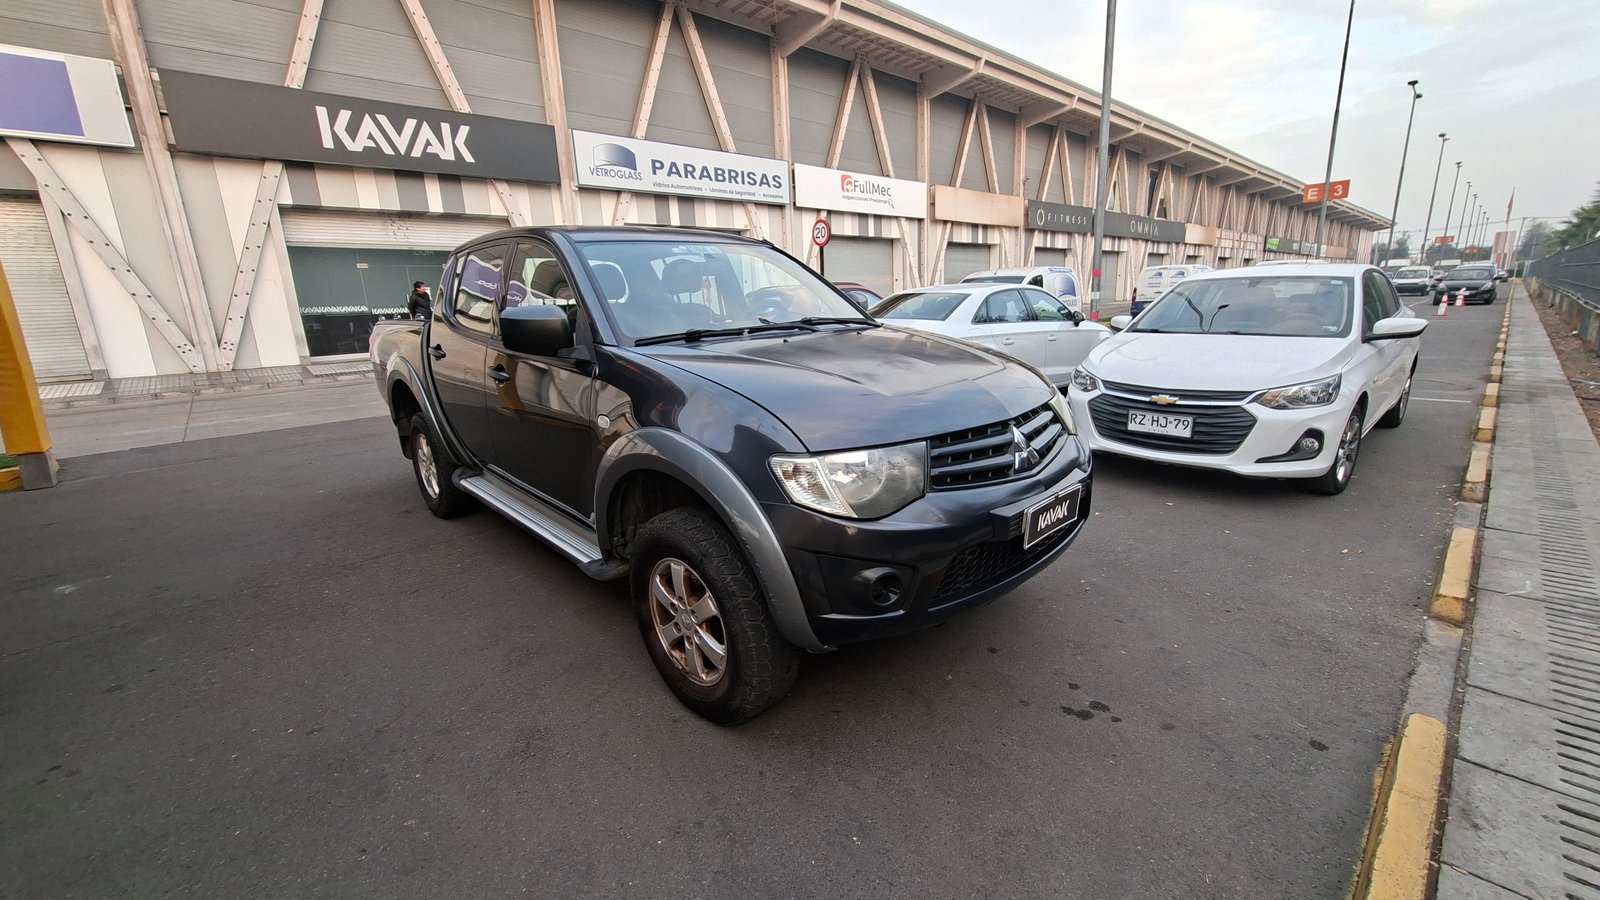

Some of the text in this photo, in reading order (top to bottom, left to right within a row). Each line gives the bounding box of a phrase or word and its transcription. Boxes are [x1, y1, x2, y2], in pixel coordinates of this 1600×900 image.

[315, 105, 476, 163] KAVAK
[588, 165, 643, 181] VETROGLASS
[651, 158, 783, 189] PARABRISAS
[652, 181, 670, 189] Vidrios
[671, 183, 703, 192] Automotrices
[853, 180, 892, 197] FullMec
[1306, 184, 1343, 200] E 3
[1047, 212, 1087, 225] FITNESS
[815, 226, 826, 239] 20
[1037, 499, 1070, 532] KAVAK
